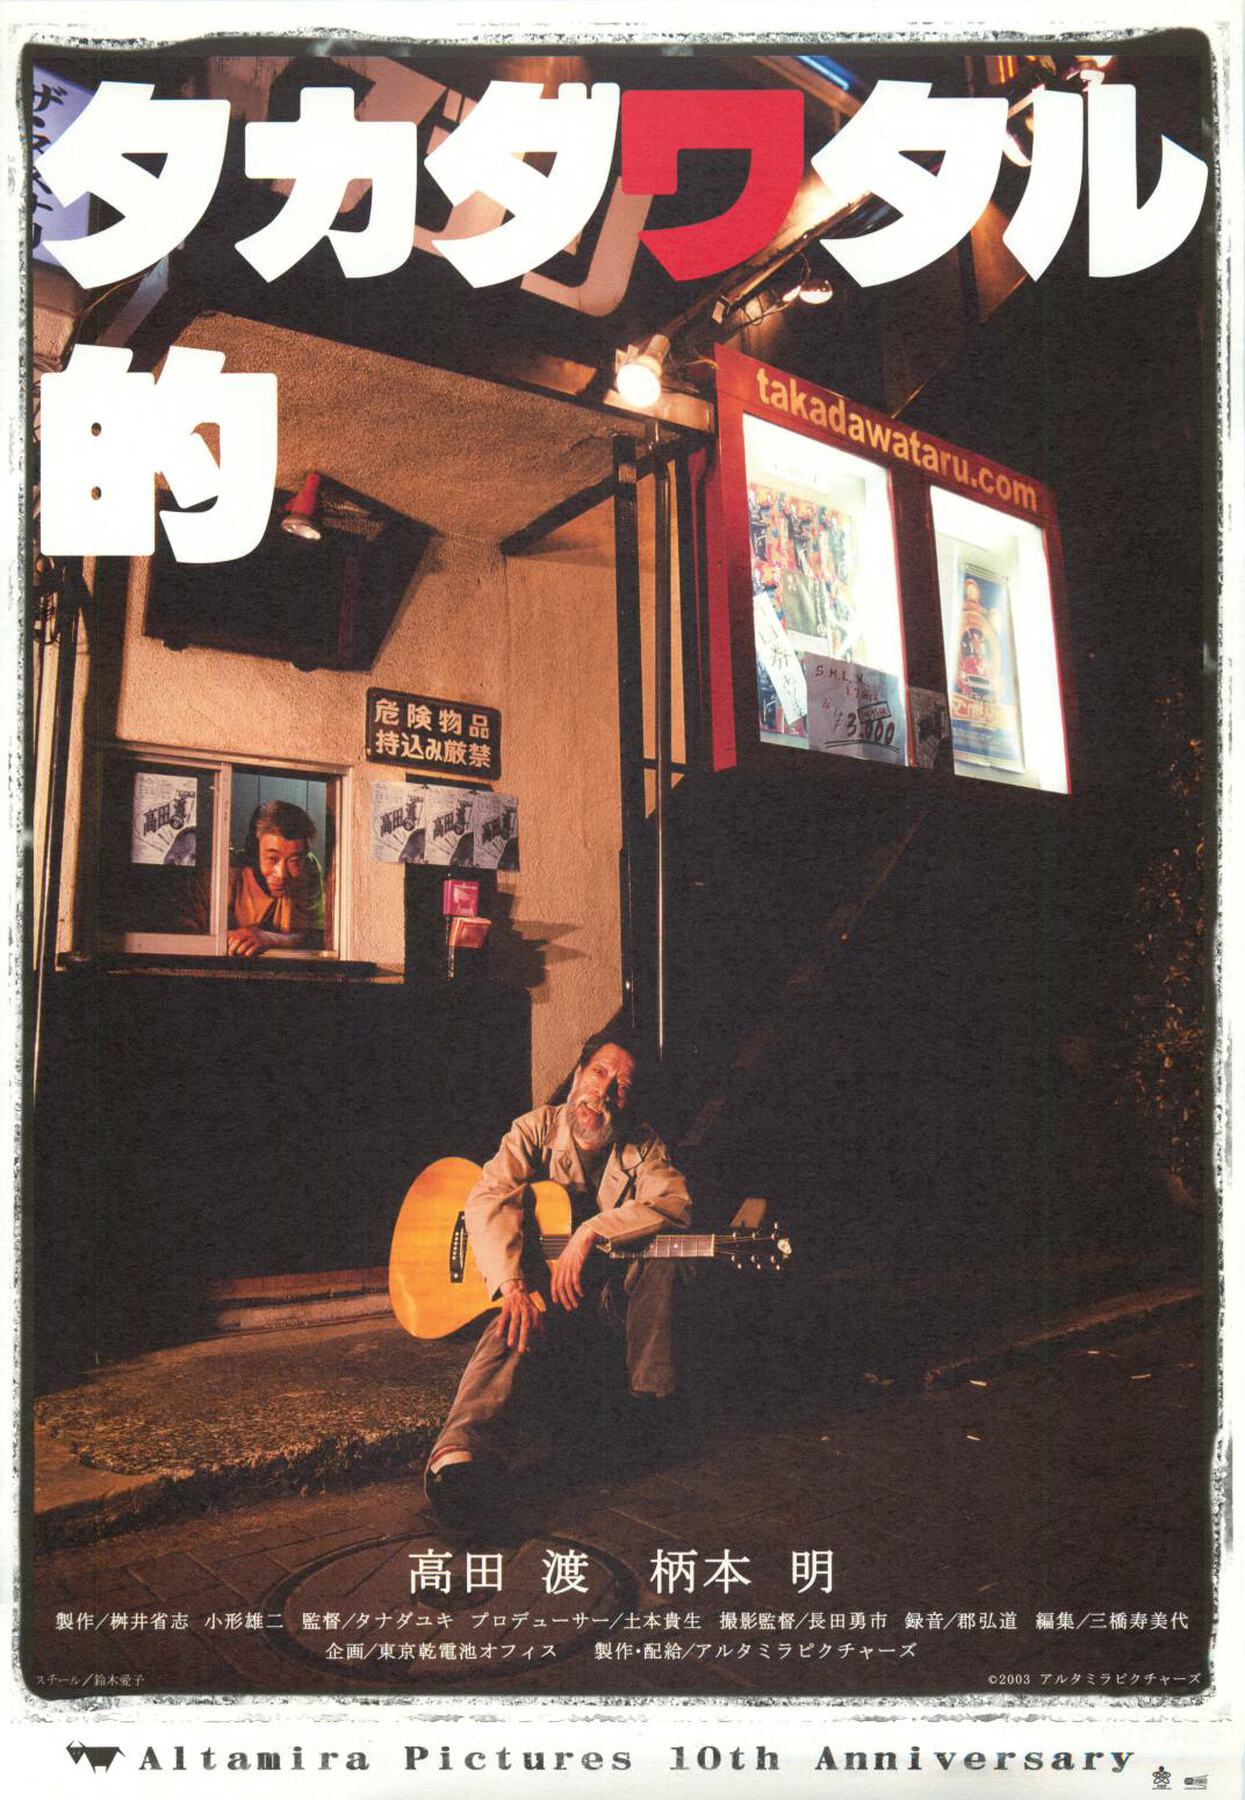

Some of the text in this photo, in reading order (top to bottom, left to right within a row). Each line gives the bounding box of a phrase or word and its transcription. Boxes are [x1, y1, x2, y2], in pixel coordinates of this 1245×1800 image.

[34, 80, 1207, 288] タカダワタル
[40, 344, 278, 563] 的
[757, 368, 1037, 512] takadawataru.com
[375, 698, 490, 739] 危険物品
[375, 729, 491, 768] 持込み厳禁
[409, 1549, 834, 1594] 高田 渡 柄本 明
[204, 1611, 283, 1631] 小形雄二
[1040, 1672, 1202, 1686] アルタミラピクチャーズ
[139, 1746, 1134, 1773] Altamira Pictures 10th Anniversary
